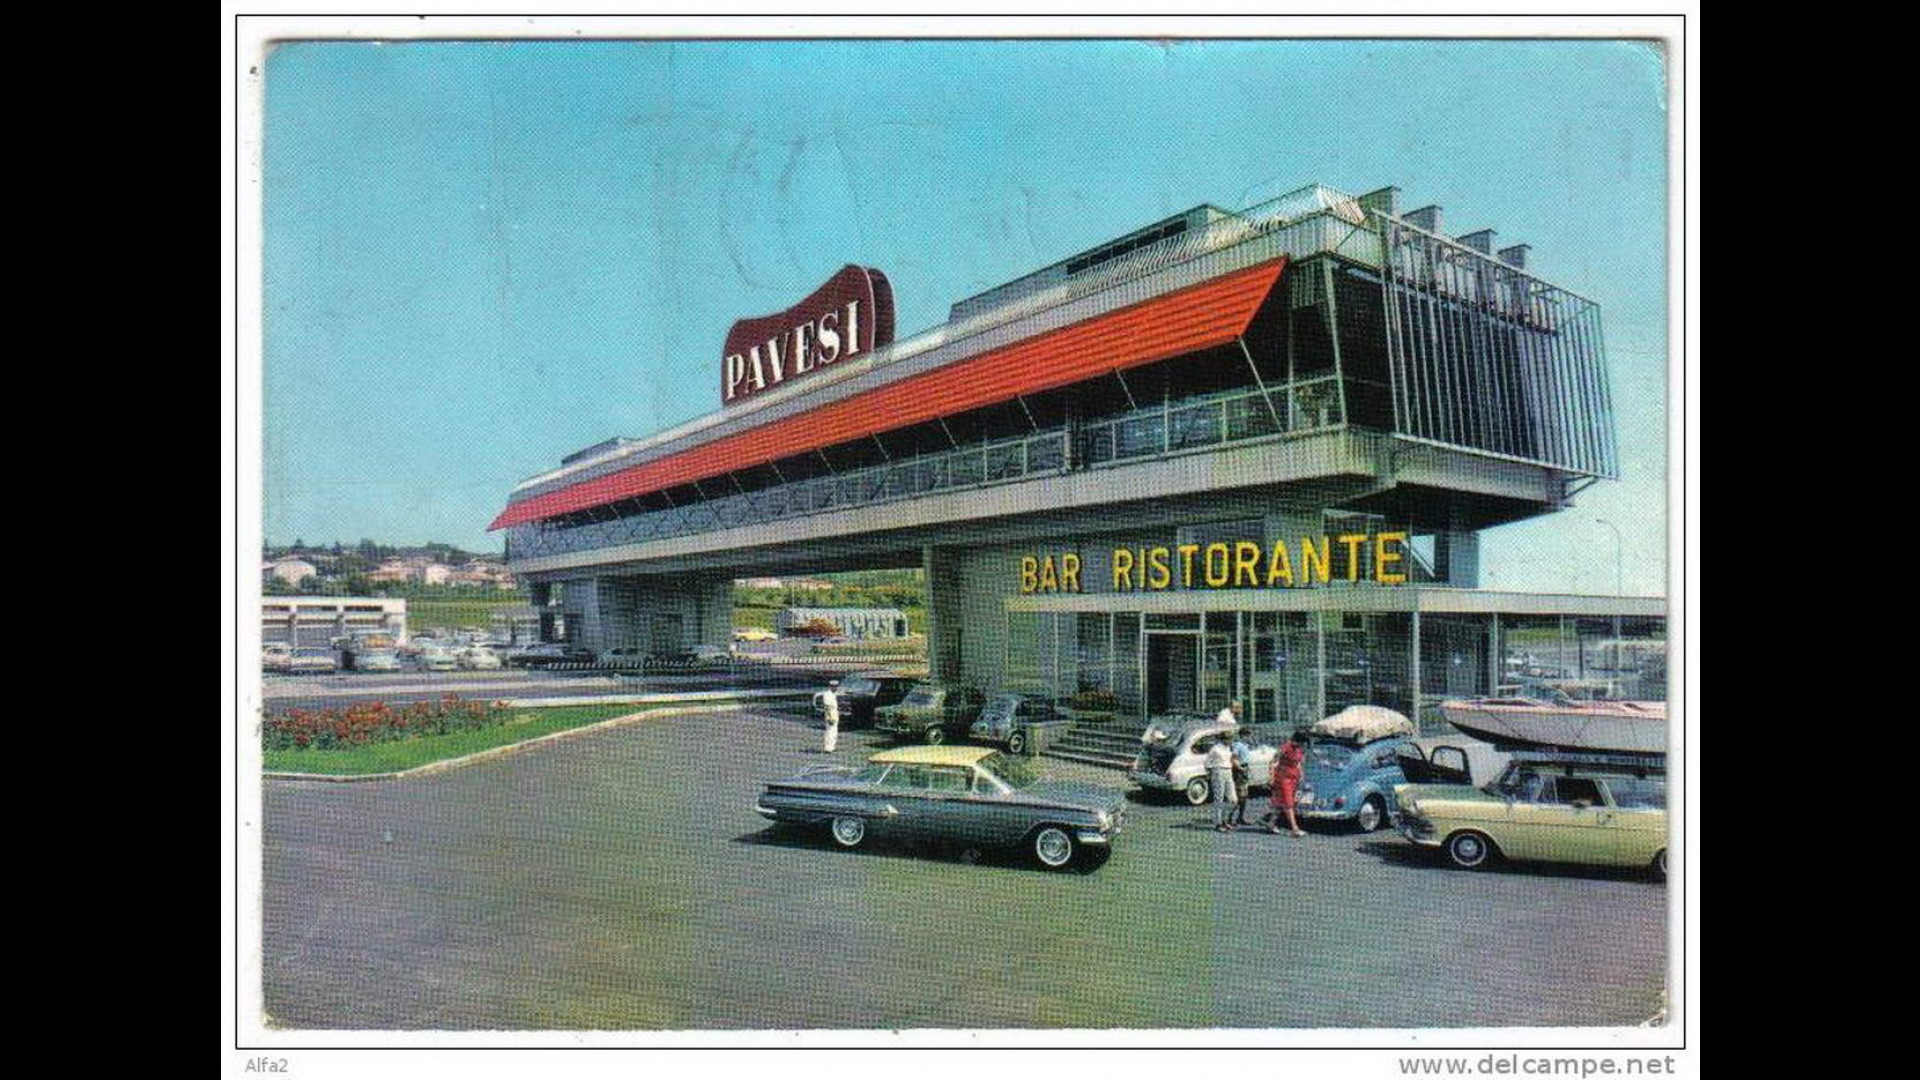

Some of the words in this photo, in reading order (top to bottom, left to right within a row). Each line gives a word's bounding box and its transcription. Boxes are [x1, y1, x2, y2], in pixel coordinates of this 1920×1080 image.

[726, 300, 860, 400] PAVESI
[1021, 553, 1082, 593] BAR
[1112, 531, 1407, 591] RISTORANTE
